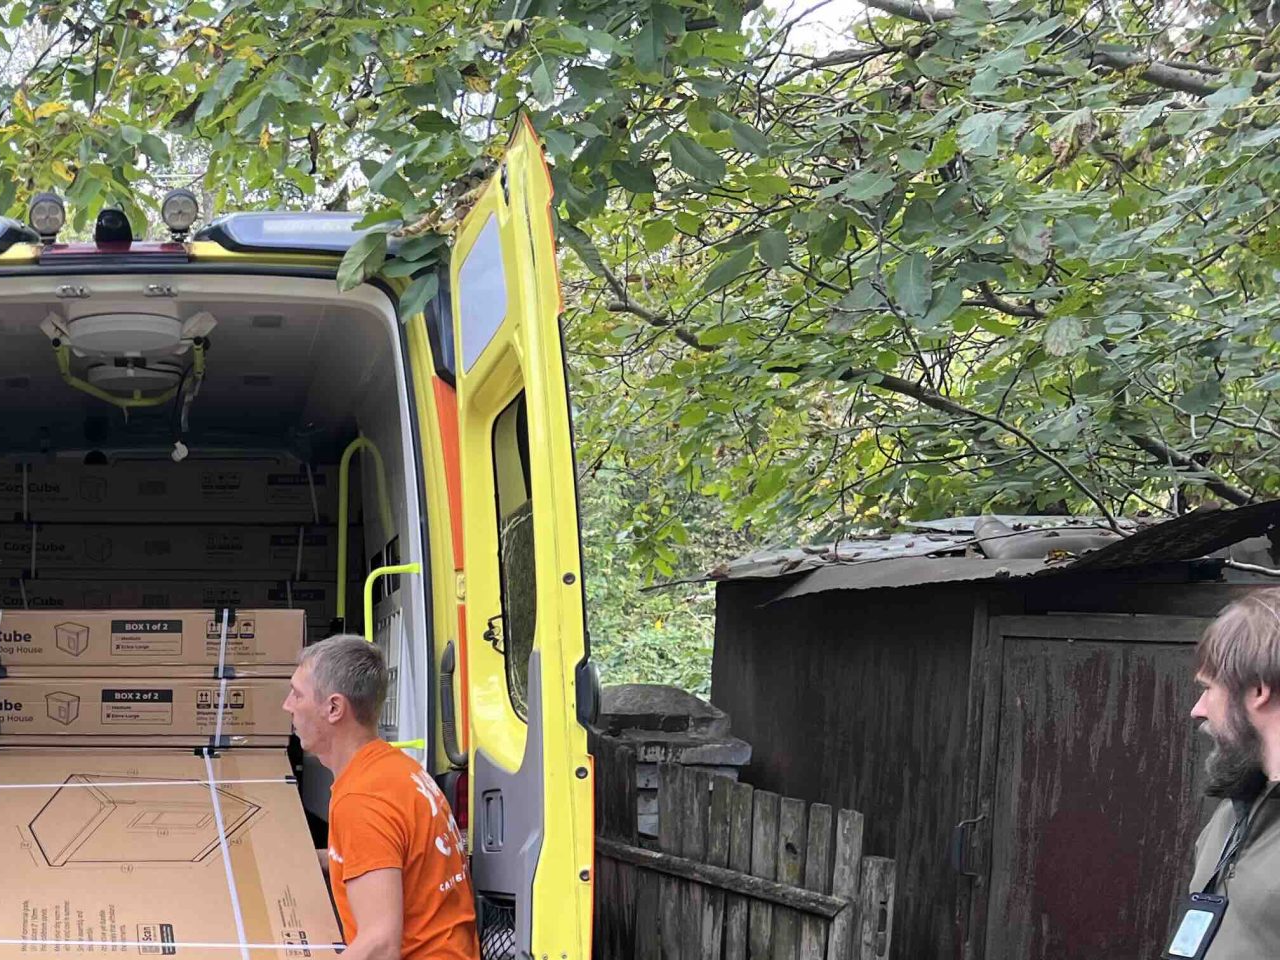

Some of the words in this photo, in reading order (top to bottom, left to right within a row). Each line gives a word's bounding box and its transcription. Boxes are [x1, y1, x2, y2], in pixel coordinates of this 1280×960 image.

[125, 623, 144, 631] BOX
[145, 623, 150, 631] 1
[151, 623, 161, 631] of
[162, 623, 168, 631] 2
[16, 645, 43, 654] House
[114, 692, 134, 700] BOX
[135, 692, 141, 700] 2
[142, 692, 152, 700] of
[153, 692, 159, 700] 2
[143, 926, 153, 942] Scan
